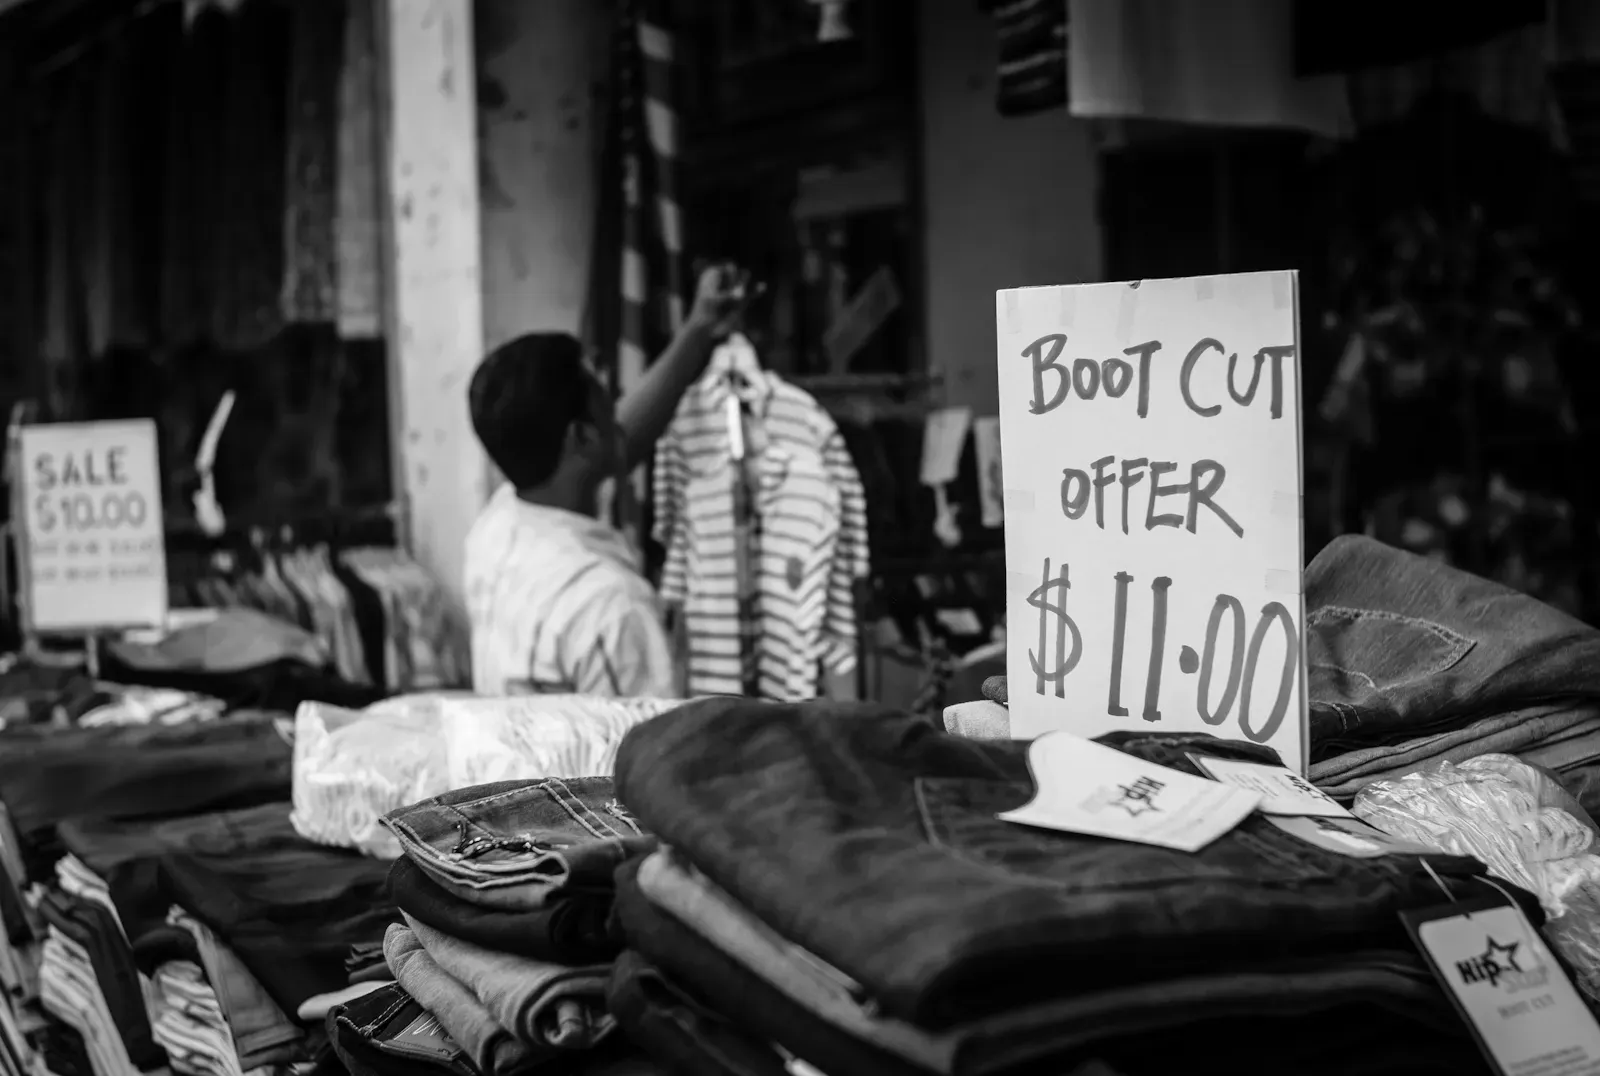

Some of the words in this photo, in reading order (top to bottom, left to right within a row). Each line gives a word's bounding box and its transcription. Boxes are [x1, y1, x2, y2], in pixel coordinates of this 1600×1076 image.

[1021, 333, 1162, 419] BOOT
[1179, 337, 1295, 419] CUT
[34, 445, 128, 491] SALE
[1060, 455, 1244, 538] OFFER
[34, 491, 147, 533] $10.00
[1026, 557, 1298, 743] $11.00
